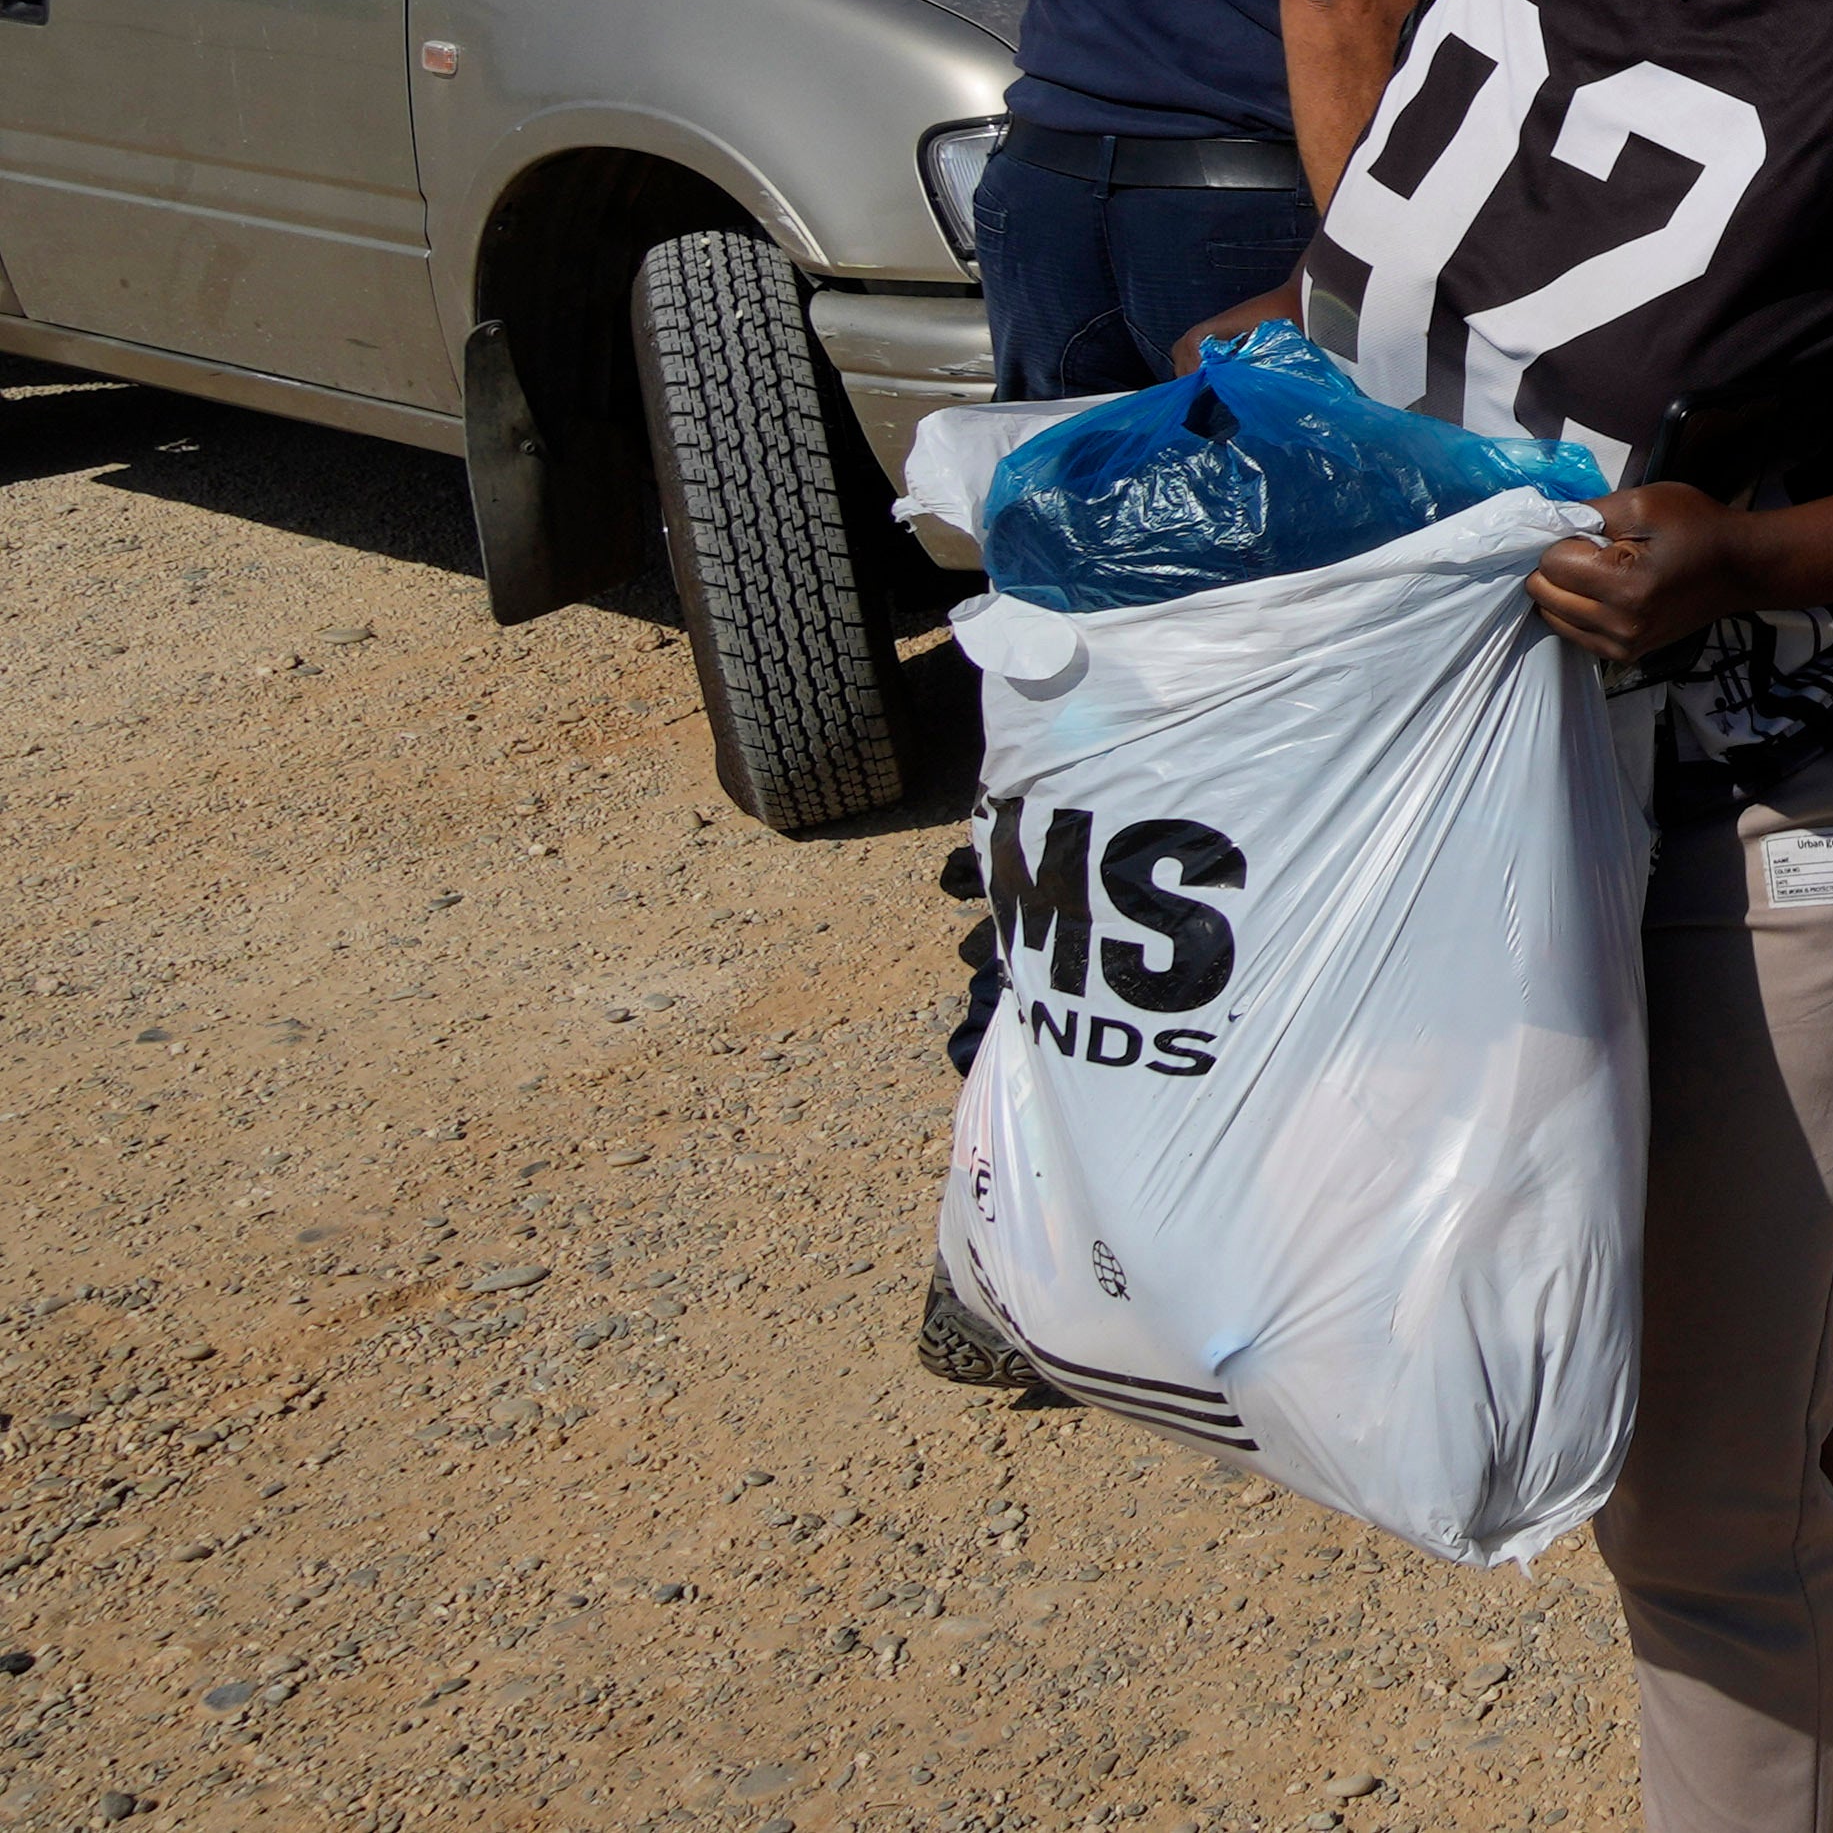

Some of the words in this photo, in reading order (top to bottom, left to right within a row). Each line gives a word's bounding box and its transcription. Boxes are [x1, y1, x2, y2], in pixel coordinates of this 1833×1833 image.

[1797, 839, 1825, 850] Urban
[974, 795, 1249, 1014] MS
[1018, 1000, 1218, 1077] NDS
